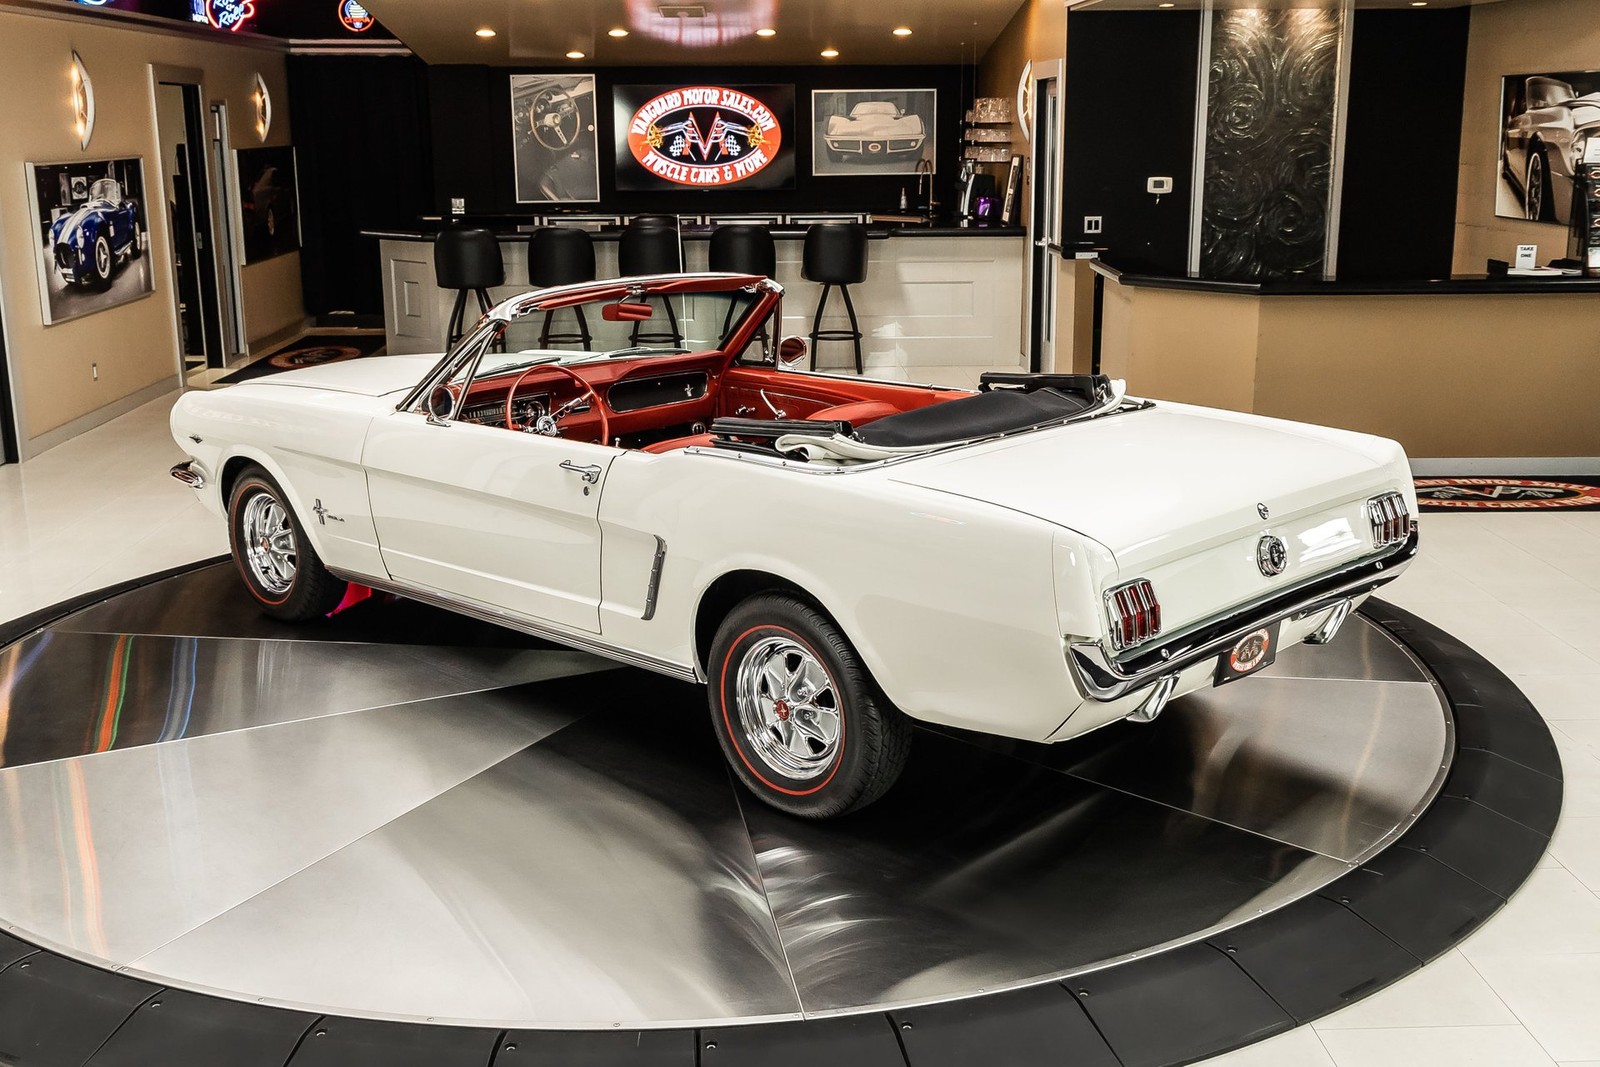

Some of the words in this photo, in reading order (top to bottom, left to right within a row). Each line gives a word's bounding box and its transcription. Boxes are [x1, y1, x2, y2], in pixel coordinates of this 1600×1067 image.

[631, 92, 682, 135] VANGUARD
[682, 88, 720, 105] MOTOR
[641, 150, 689, 181] MUSCLE
[690, 168, 720, 183] CARS
[723, 165, 733, 181] &
[734, 149, 768, 178] MORE
[1454, 478, 1522, 486] MOTOR
